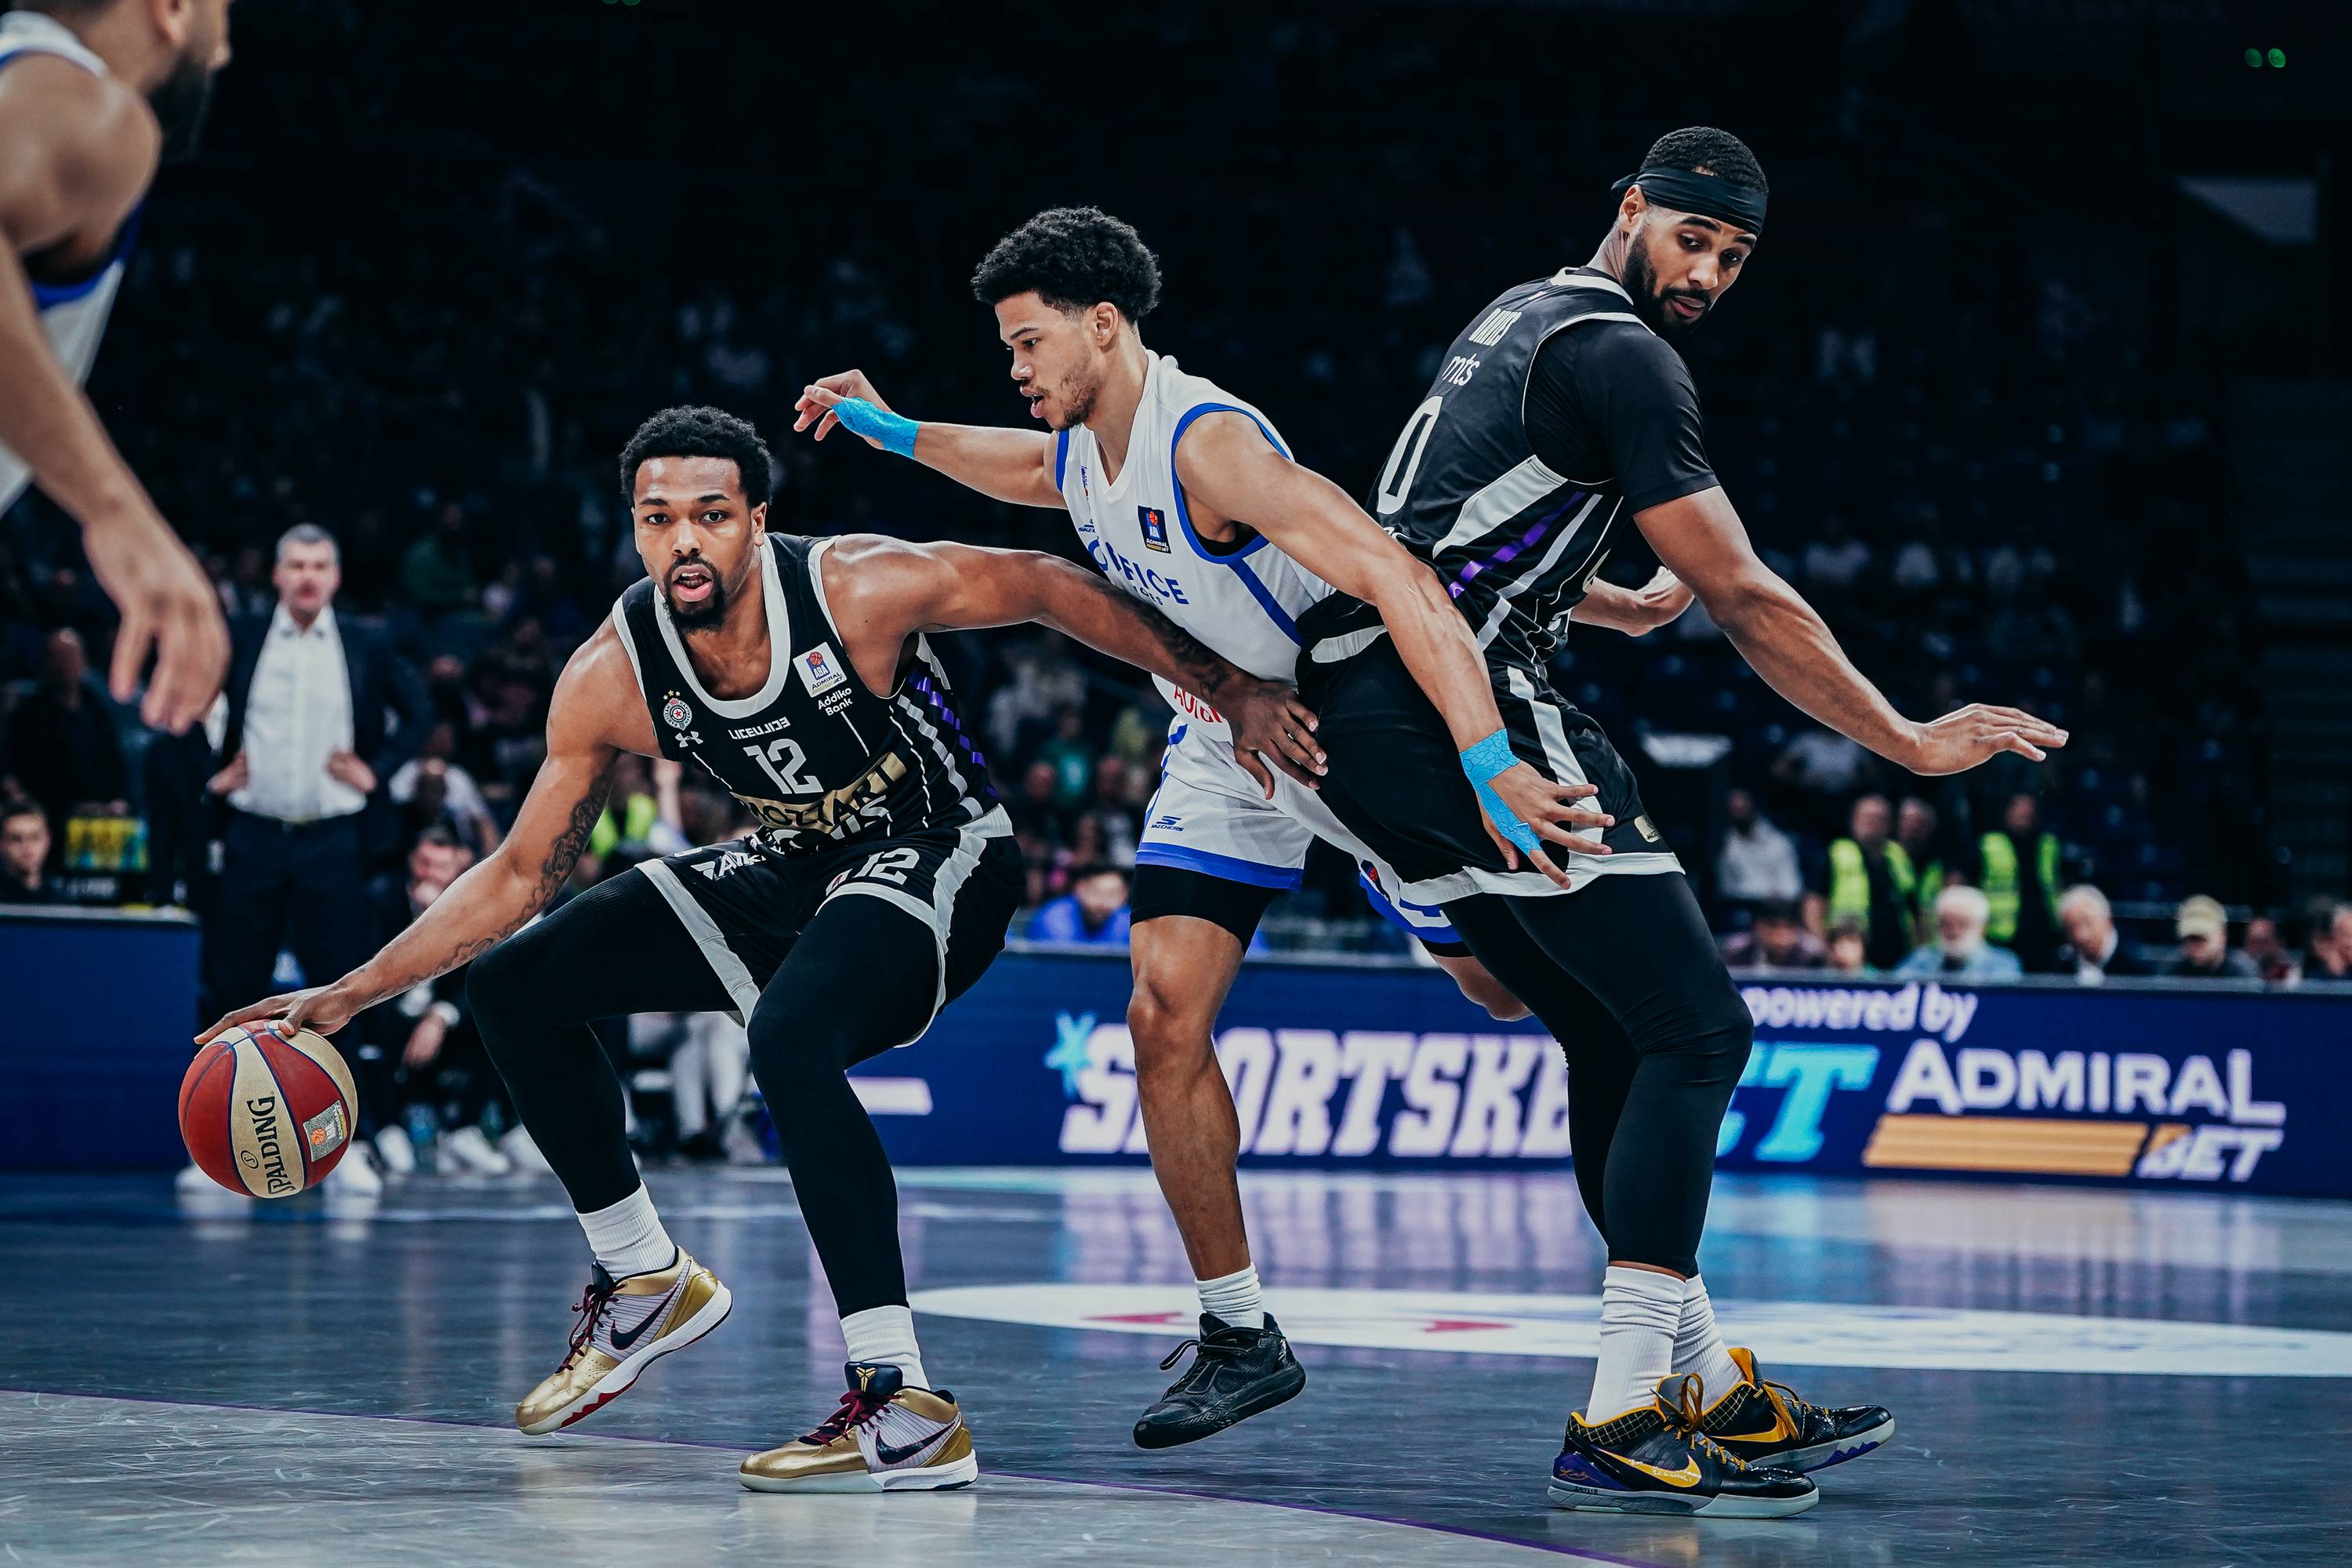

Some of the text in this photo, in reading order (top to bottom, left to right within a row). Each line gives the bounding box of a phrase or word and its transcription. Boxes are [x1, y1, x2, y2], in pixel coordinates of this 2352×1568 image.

[1442, 354, 1480, 387] mts
[1377, 395, 1443, 515] 0
[812, 672, 843, 690] ADMIRAL
[814, 665, 829, 679] ABA
[818, 688, 852, 710] Addiko
[825, 698, 853, 716] Bank
[742, 739, 824, 794] 12
[853, 848, 920, 885] 12
[1920, 982, 1978, 1044] by
[1887, 1038, 2287, 1124] ADMIRAL
[247, 1096, 296, 1195] SPALDING
[2137, 1123, 2285, 1181] BET
